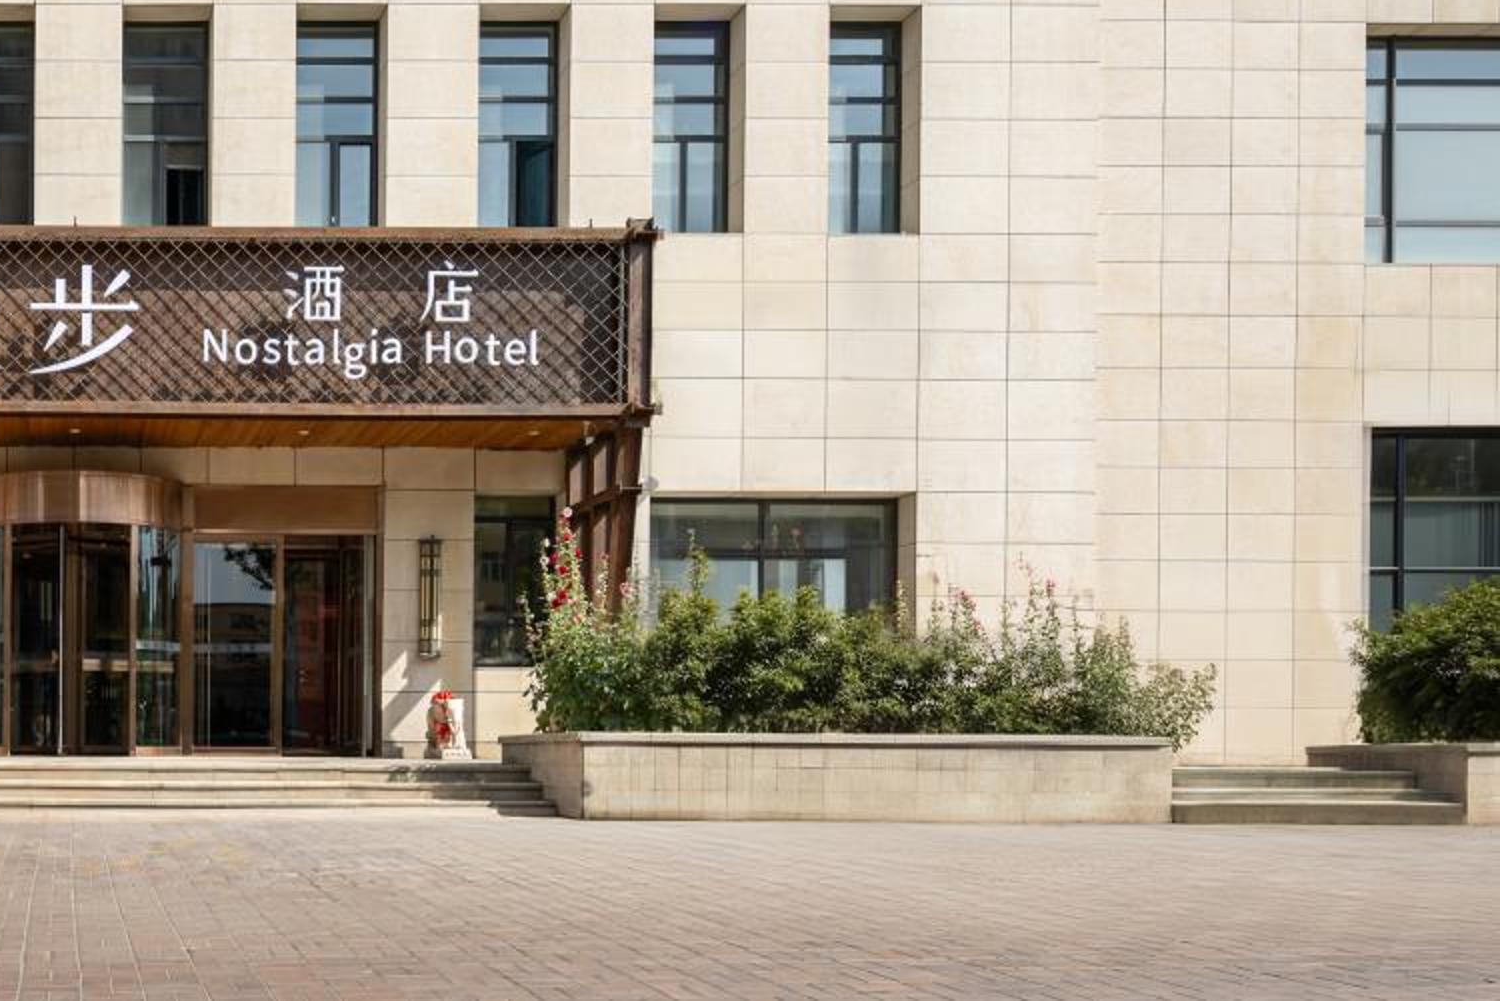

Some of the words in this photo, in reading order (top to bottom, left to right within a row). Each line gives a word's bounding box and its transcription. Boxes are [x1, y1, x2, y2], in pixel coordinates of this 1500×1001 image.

[284, 261, 479, 322] 酒店
[202, 328, 403, 380] Nostalgia
[425, 329, 540, 366] Hotel
